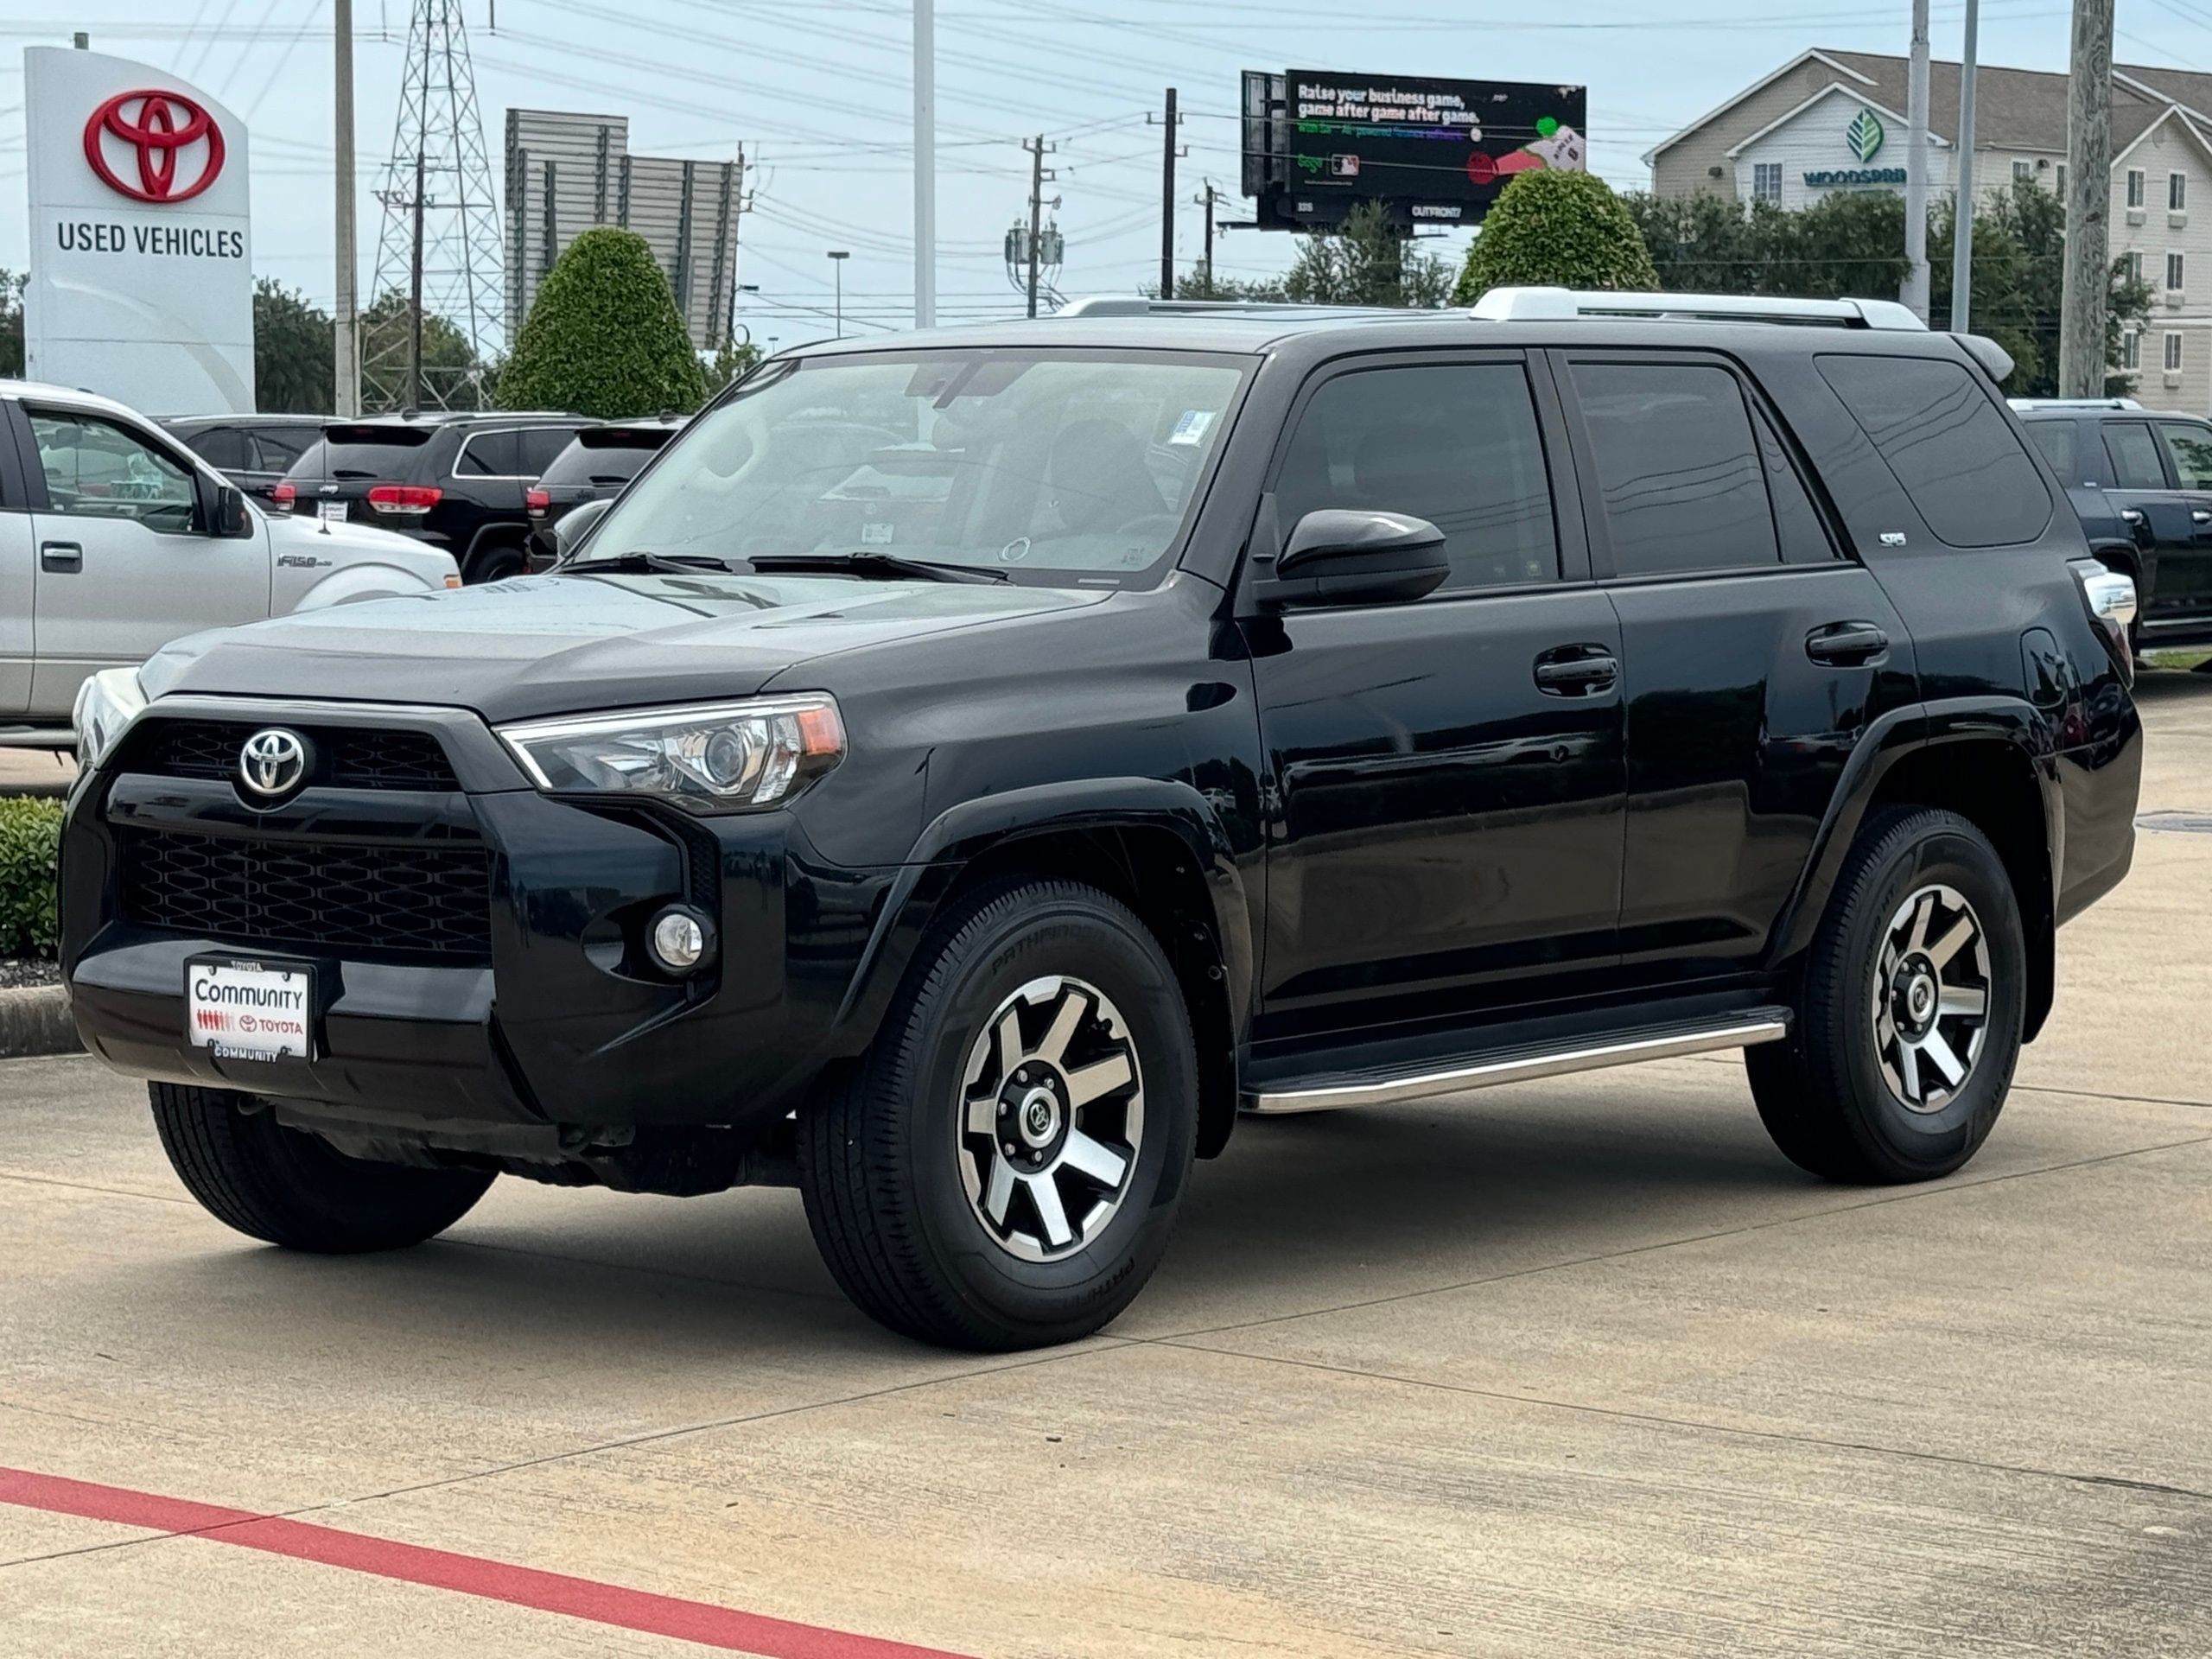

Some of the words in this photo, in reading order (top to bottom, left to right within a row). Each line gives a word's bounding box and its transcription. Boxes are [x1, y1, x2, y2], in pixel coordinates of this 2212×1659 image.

[1298, 84, 1336, 101] Raise
[1337, 88, 1367, 105] your
[1368, 87, 1426, 105] business
[1427, 94, 1465, 110] game,
[1298, 104, 1334, 119] game
[1335, 103, 1370, 118] after
[1371, 106, 1407, 122] game
[1408, 106, 1440, 122] after
[58, 222, 126, 252] USED
[133, 226, 244, 258] VEHICLES
[231, 961, 264, 972] TOYOTA
[259, 1020, 303, 1035] TOYOTA
[214, 1046, 279, 1064] COMMUNITY
